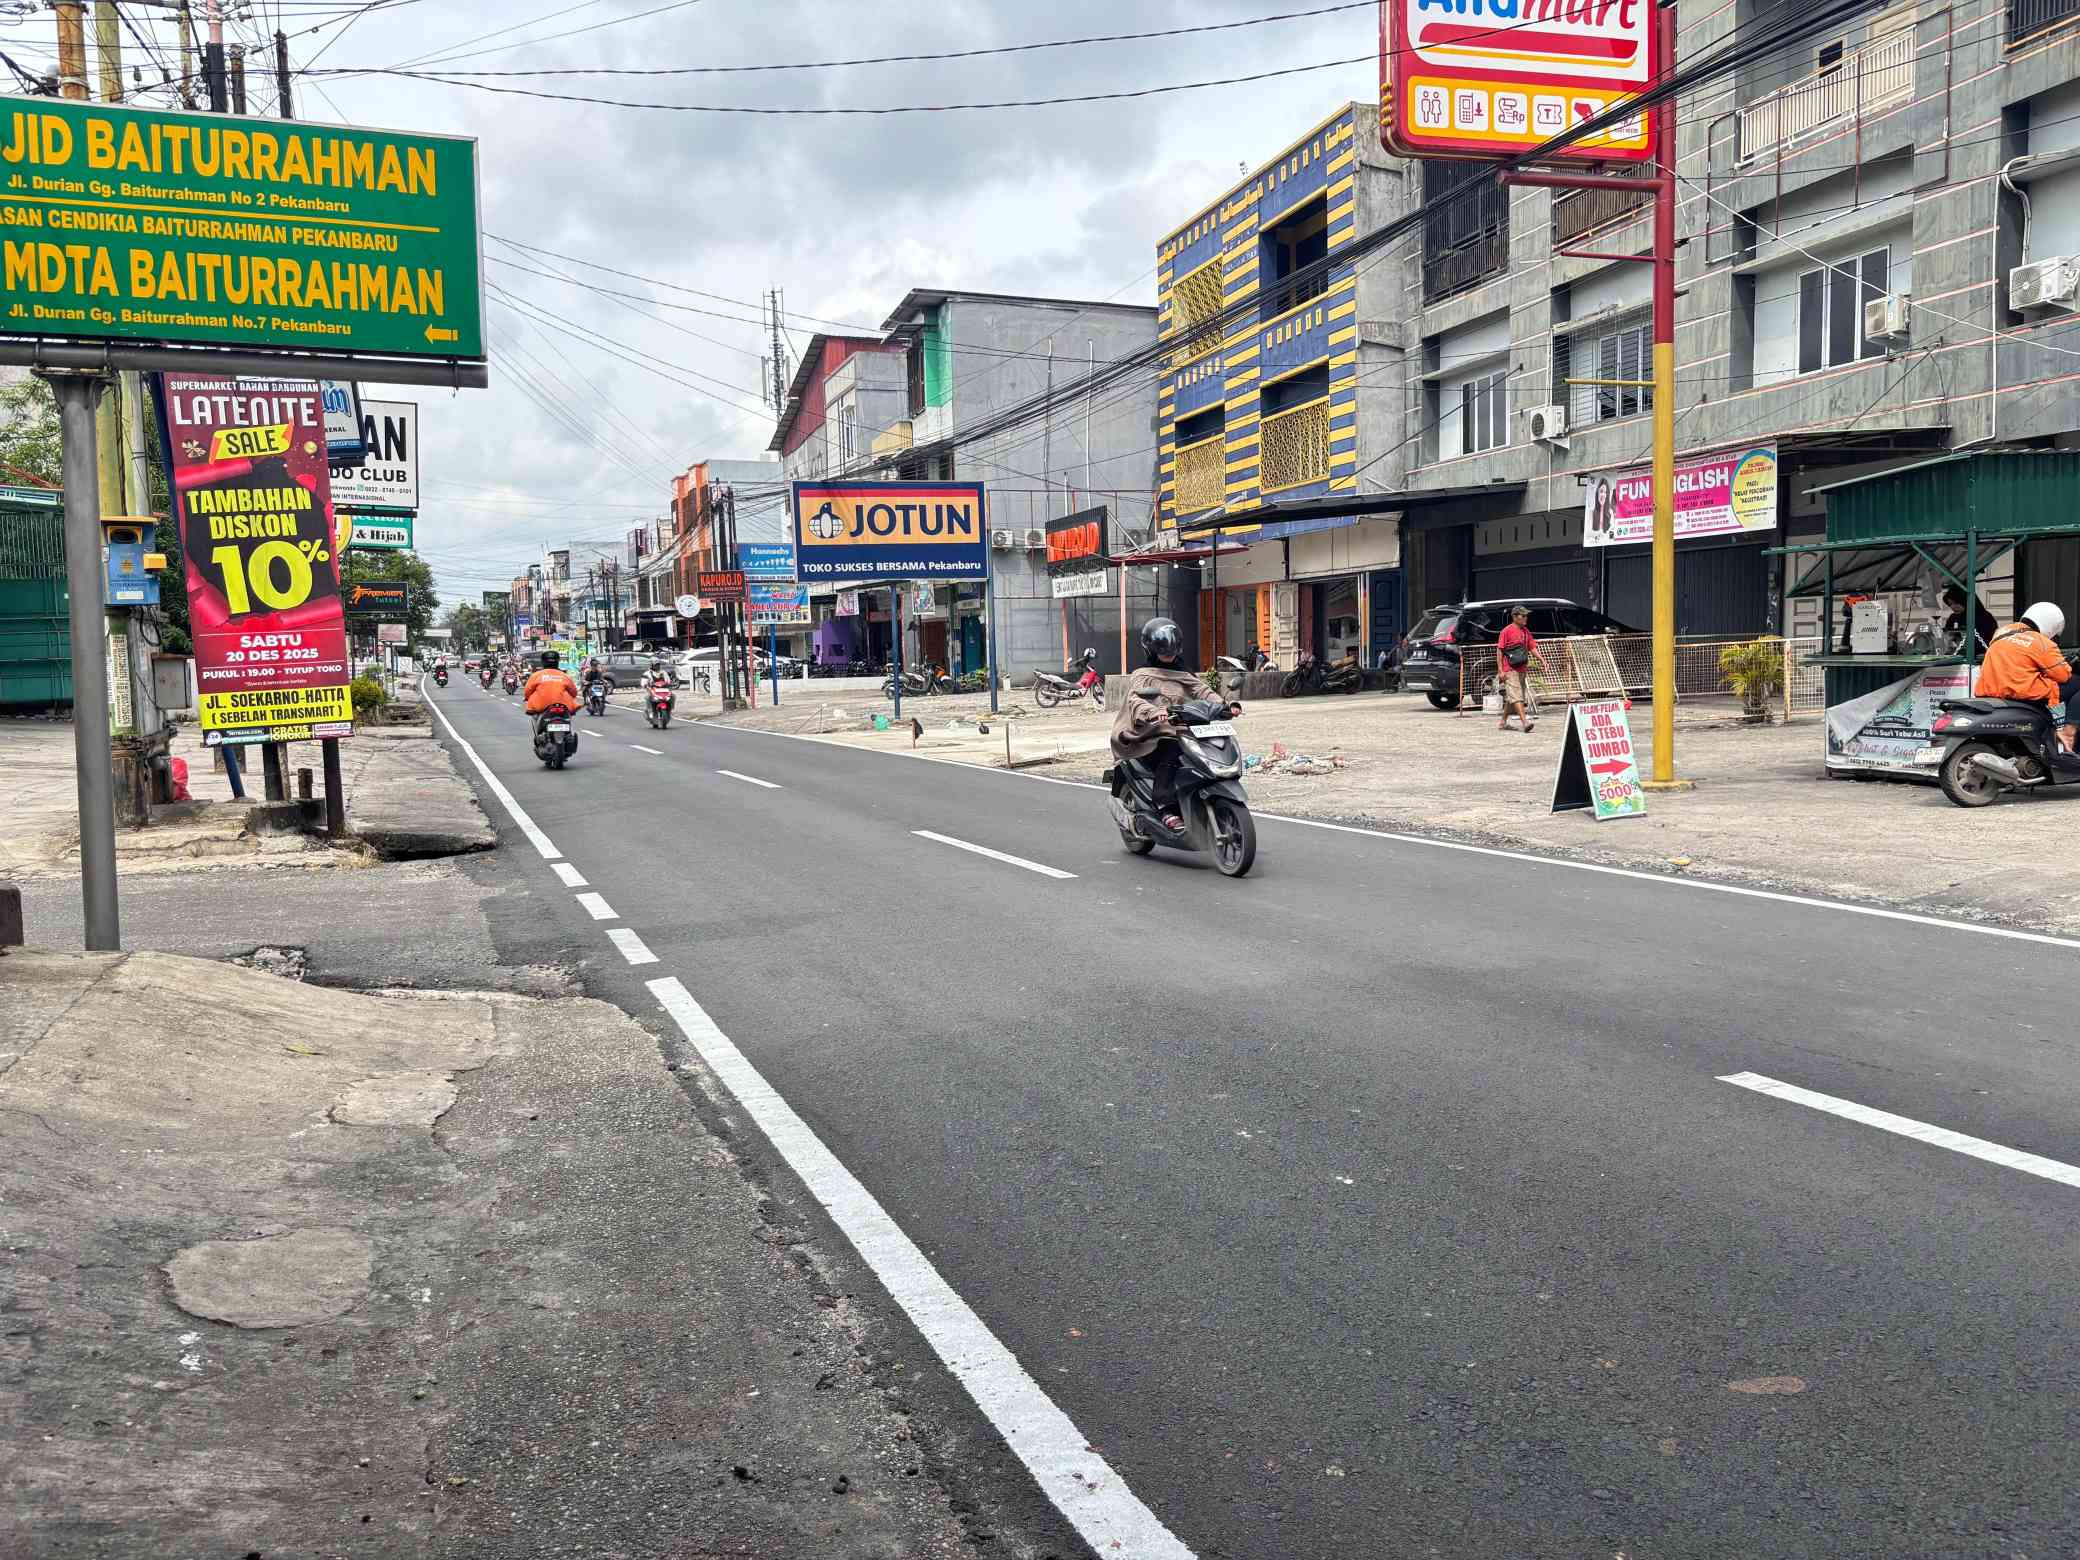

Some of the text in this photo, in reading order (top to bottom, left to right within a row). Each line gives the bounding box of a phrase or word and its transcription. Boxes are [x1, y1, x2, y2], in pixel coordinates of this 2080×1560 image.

[0, 111, 437, 197] JID BAITURRAHMAN
[8, 174, 351, 213] Jl. Durian Gg. Baiturrahman No 2 Pekanbaru
[0, 206, 398, 253] SAN CENDIKIA BAITURRAHMAN PEKANBARU
[3, 240, 444, 317] MDTA BAITURRAHMAN
[9, 304, 352, 335] Jl. Durian Gg. Baiturrahman No.7 Pekanbaru
[170, 381, 237, 391] SUPERMARKET
[172, 395, 319, 428] LATENITE
[225, 429, 280, 456] SALE
[364, 414, 407, 462] AN
[329, 467, 408, 483] DO CLUB
[1617, 479, 1651, 502] FUN
[1672, 466, 1730, 494] GLISH
[186, 487, 313, 515] TAMBAHAN
[209, 513, 298, 540] DISKON
[849, 503, 972, 538] JOTUN
[369, 529, 406, 543] Hijab
[210, 538, 330, 616] 10%
[803, 560, 982, 573] TOKO SUKSES BERSAMA Pekanbaru
[240, 633, 302, 649] SABTU
[226, 647, 319, 663] 20 DES 2025
[202, 669, 240, 680] PUKUL
[247, 668, 276, 678] 19.00
[284, 666, 315, 676] TUTUP
[317, 664, 343, 674] TOKO
[206, 688, 346, 710] JL. SOEKARNO-HATTA
[220, 709, 268, 725] SEBELAH
[271, 705, 334, 722] TRANSMART
[1591, 714, 1612, 727] ADA
[273, 725, 309, 734] GRATIS
[1585, 725, 1625, 740] ES TEBU
[1587, 740, 1631, 758] JUMBO
[1600, 785, 1632, 801] 5000
